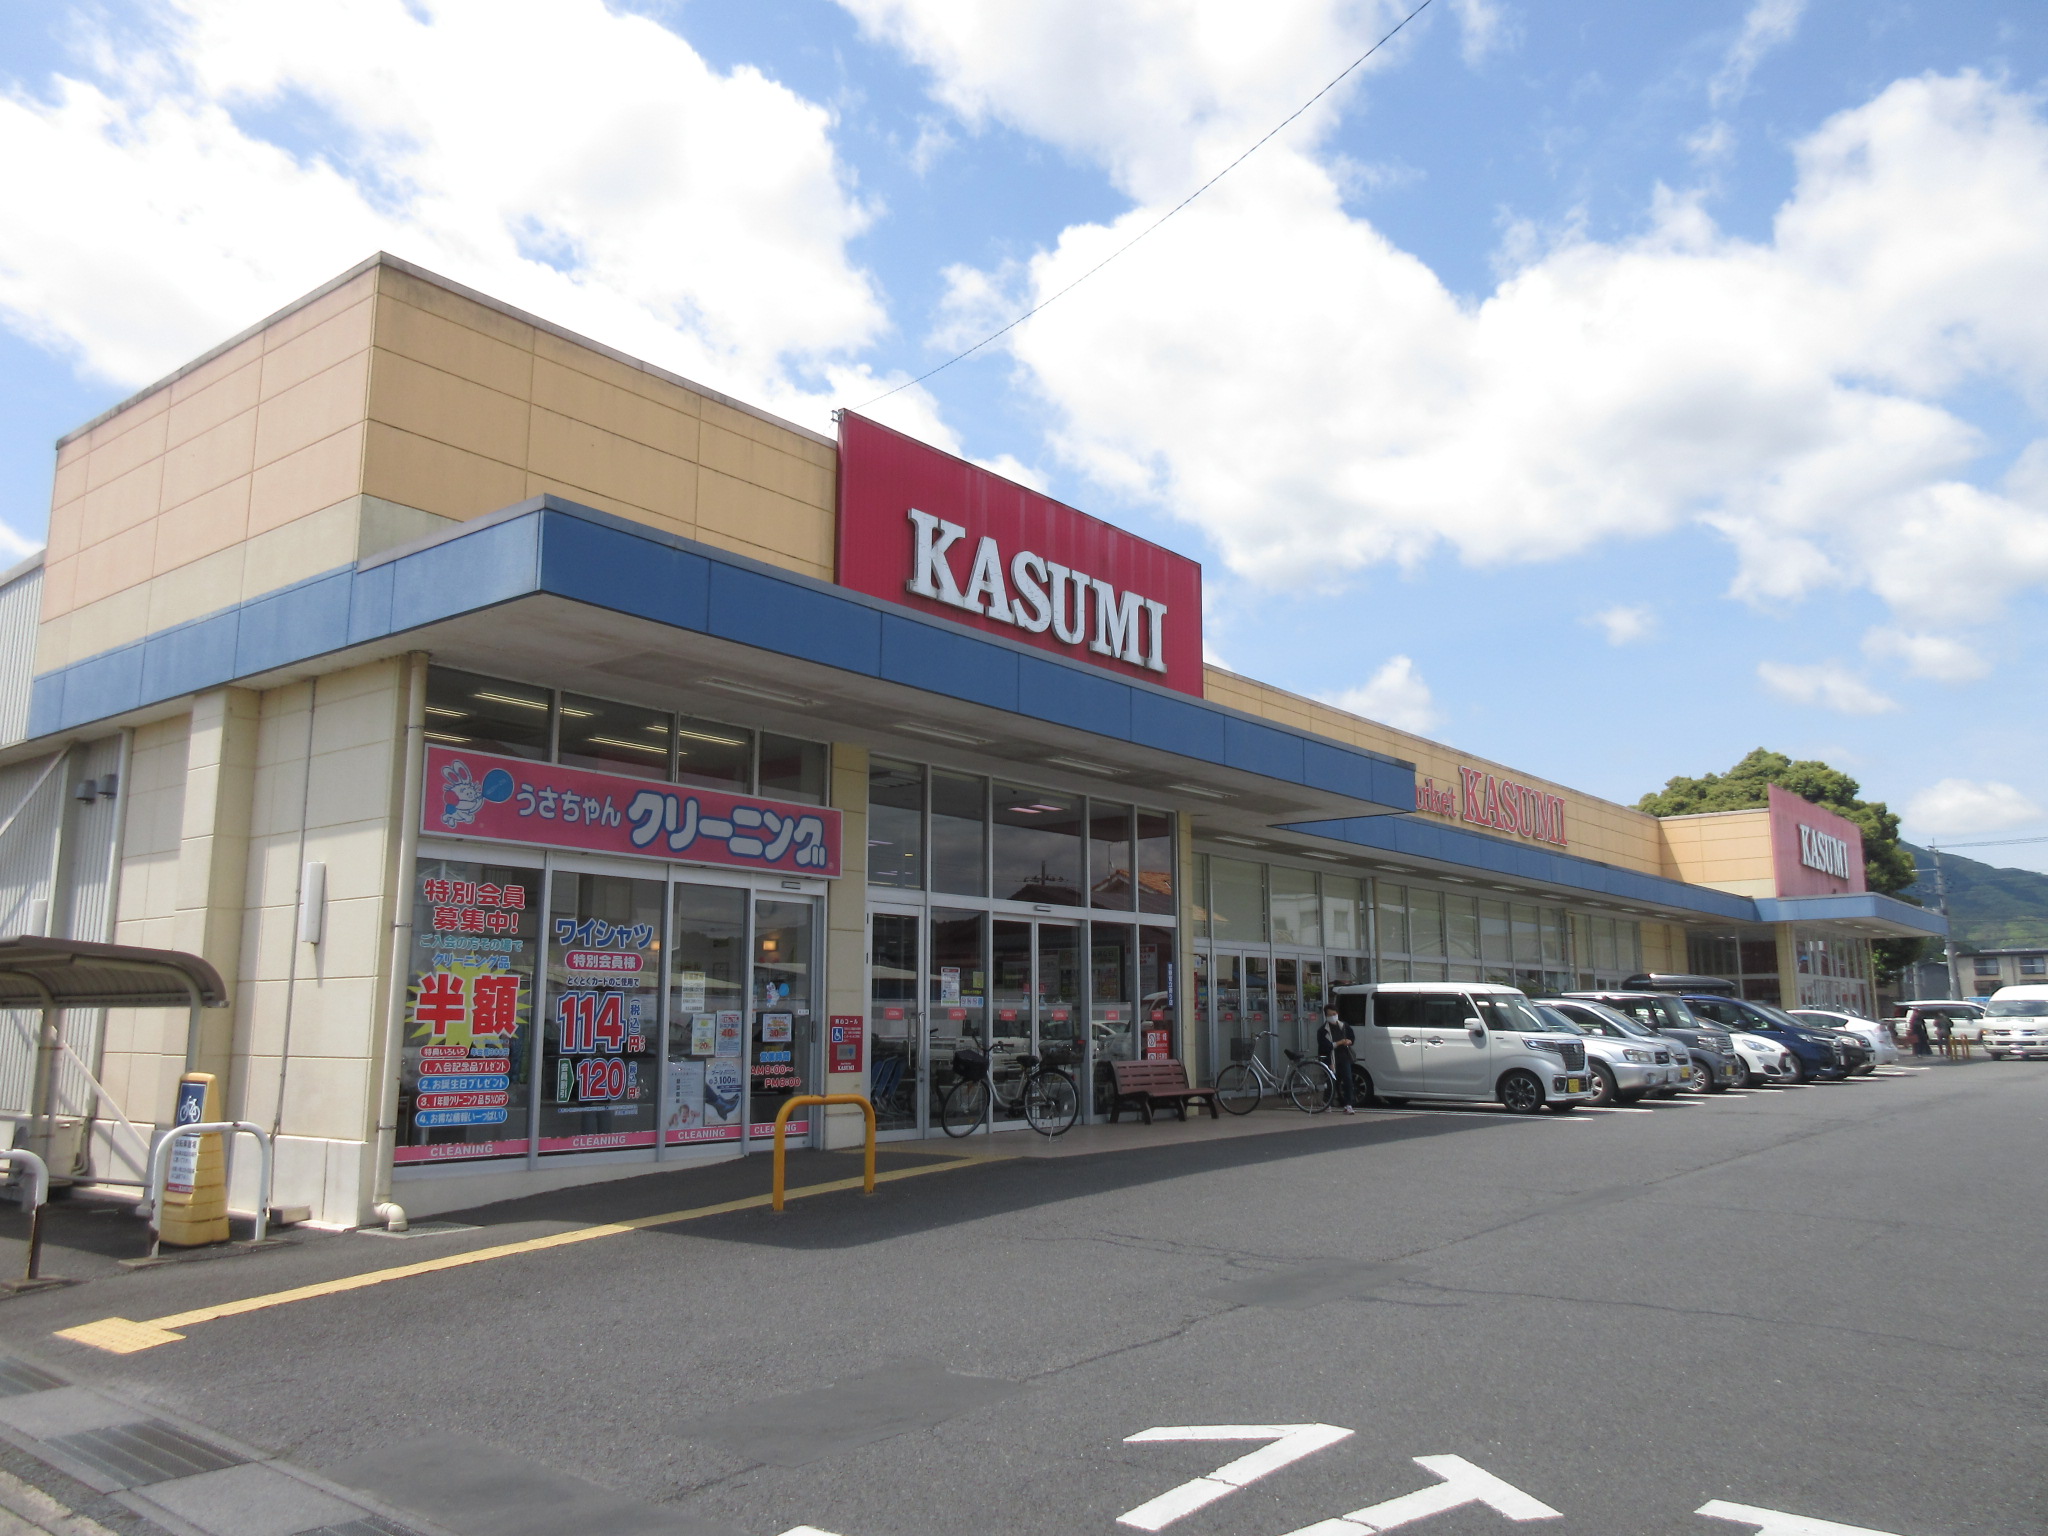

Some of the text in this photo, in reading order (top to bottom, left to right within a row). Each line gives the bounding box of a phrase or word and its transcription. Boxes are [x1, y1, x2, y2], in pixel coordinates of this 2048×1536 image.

[906, 507, 1168, 674] KASUMI
[1458, 765, 1568, 847] KASUMI
[516, 783, 827, 869] うさちゃん クリーニング
[1798, 823, 1849, 879] KASUMI
[424, 878, 525, 909] 特別会員
[433, 905, 519, 934] 募集中!
[556, 918, 654, 949] ワイシャツ
[420, 933, 524, 953] ご入会の方その場で
[432, 952, 511, 970] クリーニング品
[573, 953, 636, 970] 特別会員様
[413, 972, 521, 1039] 半額
[556, 990, 628, 1054] 114
[577, 1058, 627, 1101] 120
[573, 1135, 626, 1147] CLEANING
[678, 1128, 726, 1140] CLEANING
[754, 1123, 797, 1134] CLEANG
[430, 1144, 493, 1157] CLEANING
